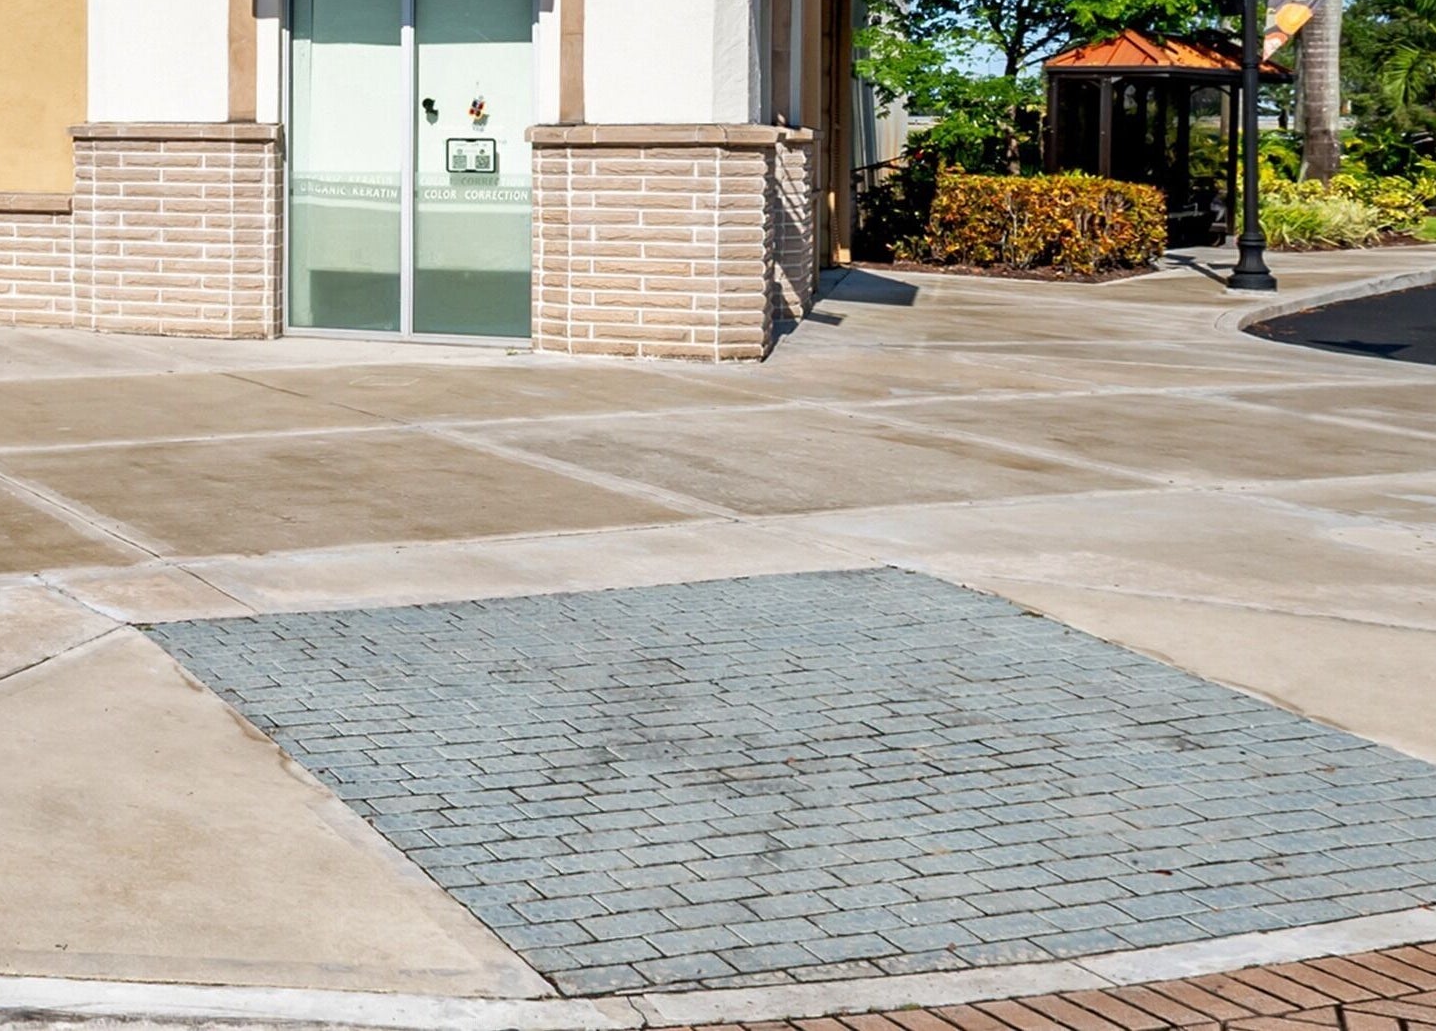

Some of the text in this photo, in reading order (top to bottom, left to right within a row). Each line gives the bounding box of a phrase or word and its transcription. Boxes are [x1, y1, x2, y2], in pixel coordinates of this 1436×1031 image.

[300, 181, 398, 199] ORGANIC KERATIN
[424, 189, 528, 201] COLOR CORRECTION
